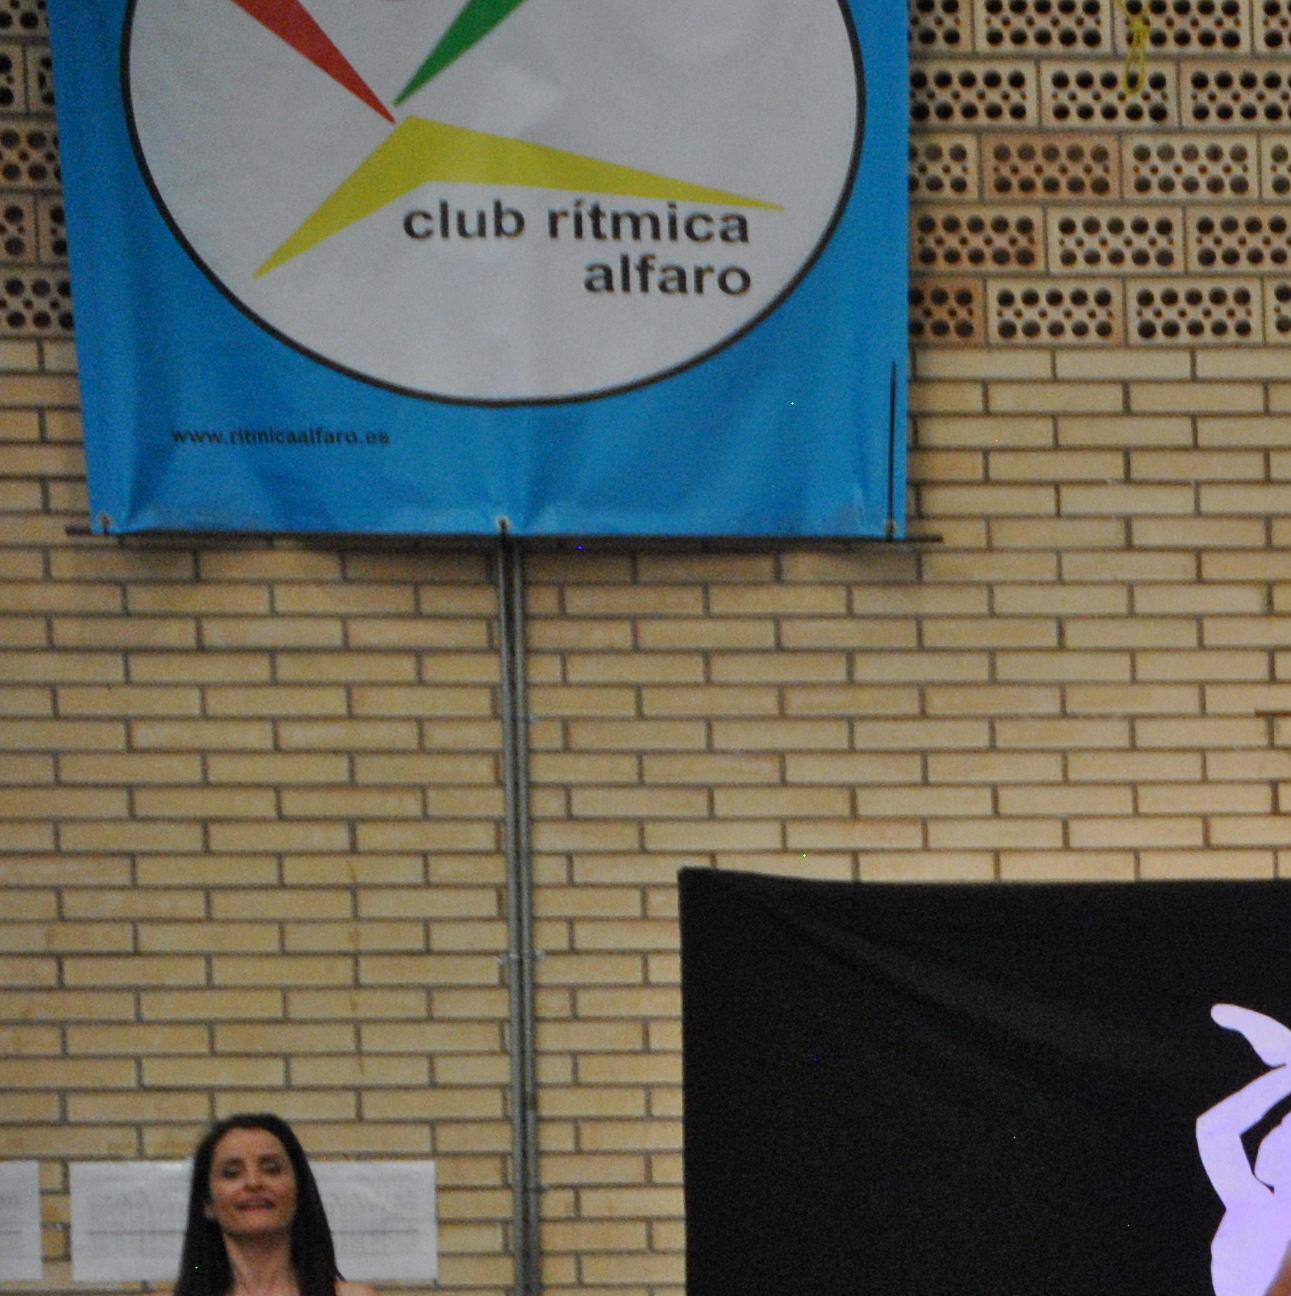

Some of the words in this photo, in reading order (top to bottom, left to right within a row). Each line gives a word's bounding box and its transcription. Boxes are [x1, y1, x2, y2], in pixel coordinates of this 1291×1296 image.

[403, 200, 526, 241] club
[547, 200, 751, 244] rítmica
[584, 254, 752, 297] alfaro
